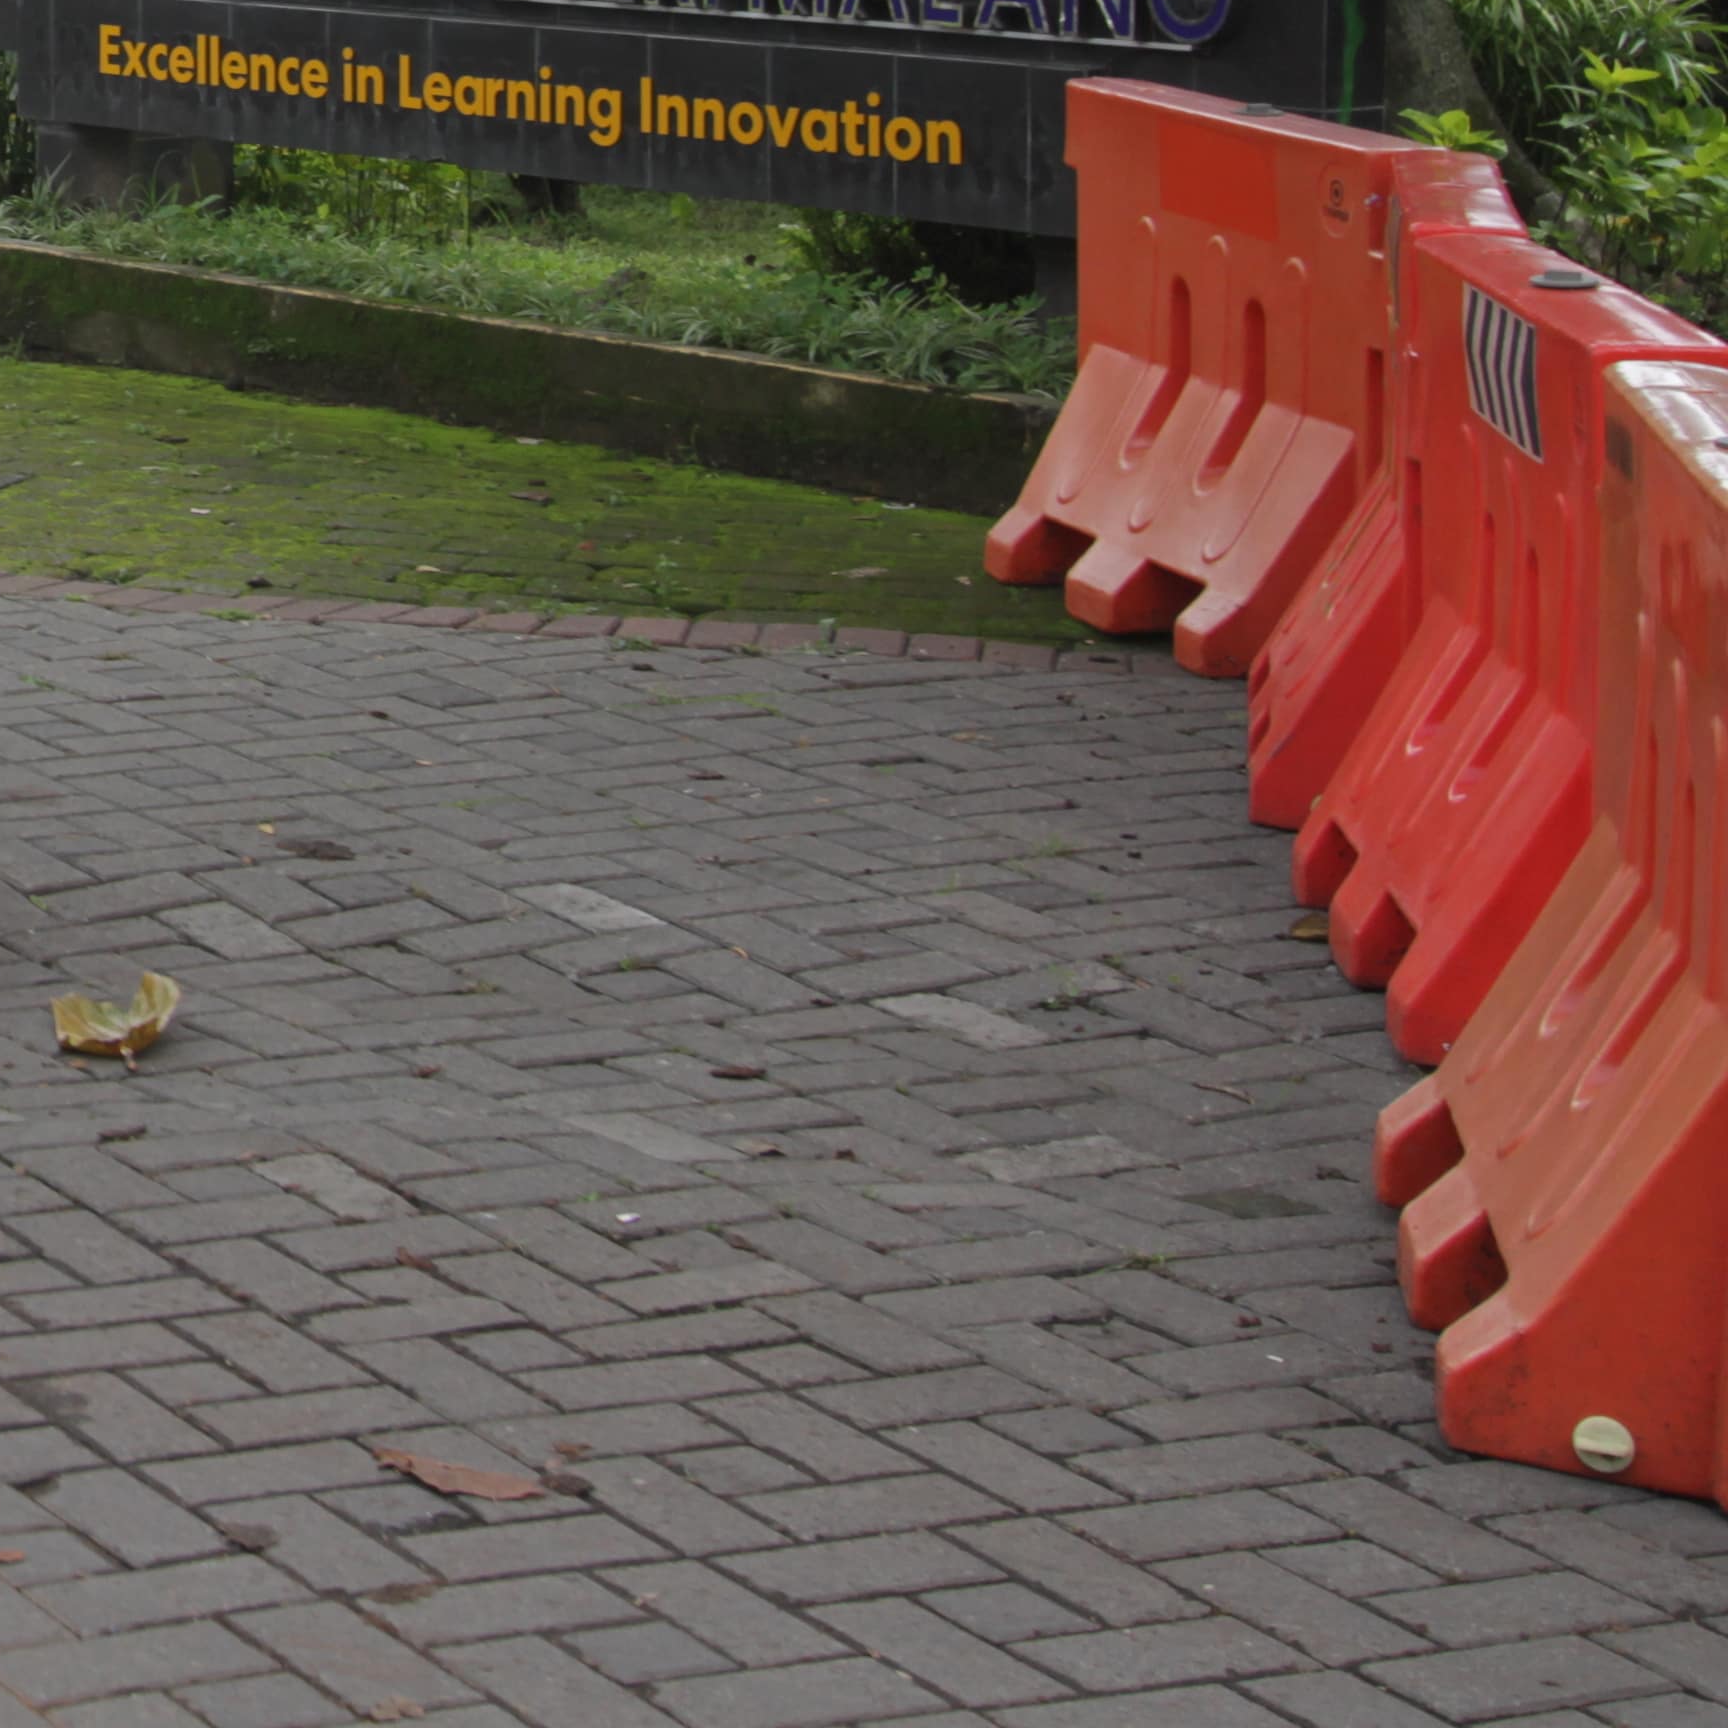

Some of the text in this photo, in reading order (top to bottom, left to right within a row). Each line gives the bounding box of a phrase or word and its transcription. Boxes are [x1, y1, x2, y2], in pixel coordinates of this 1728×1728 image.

[97, 23, 963, 165] Excellence in Learning Innovation
